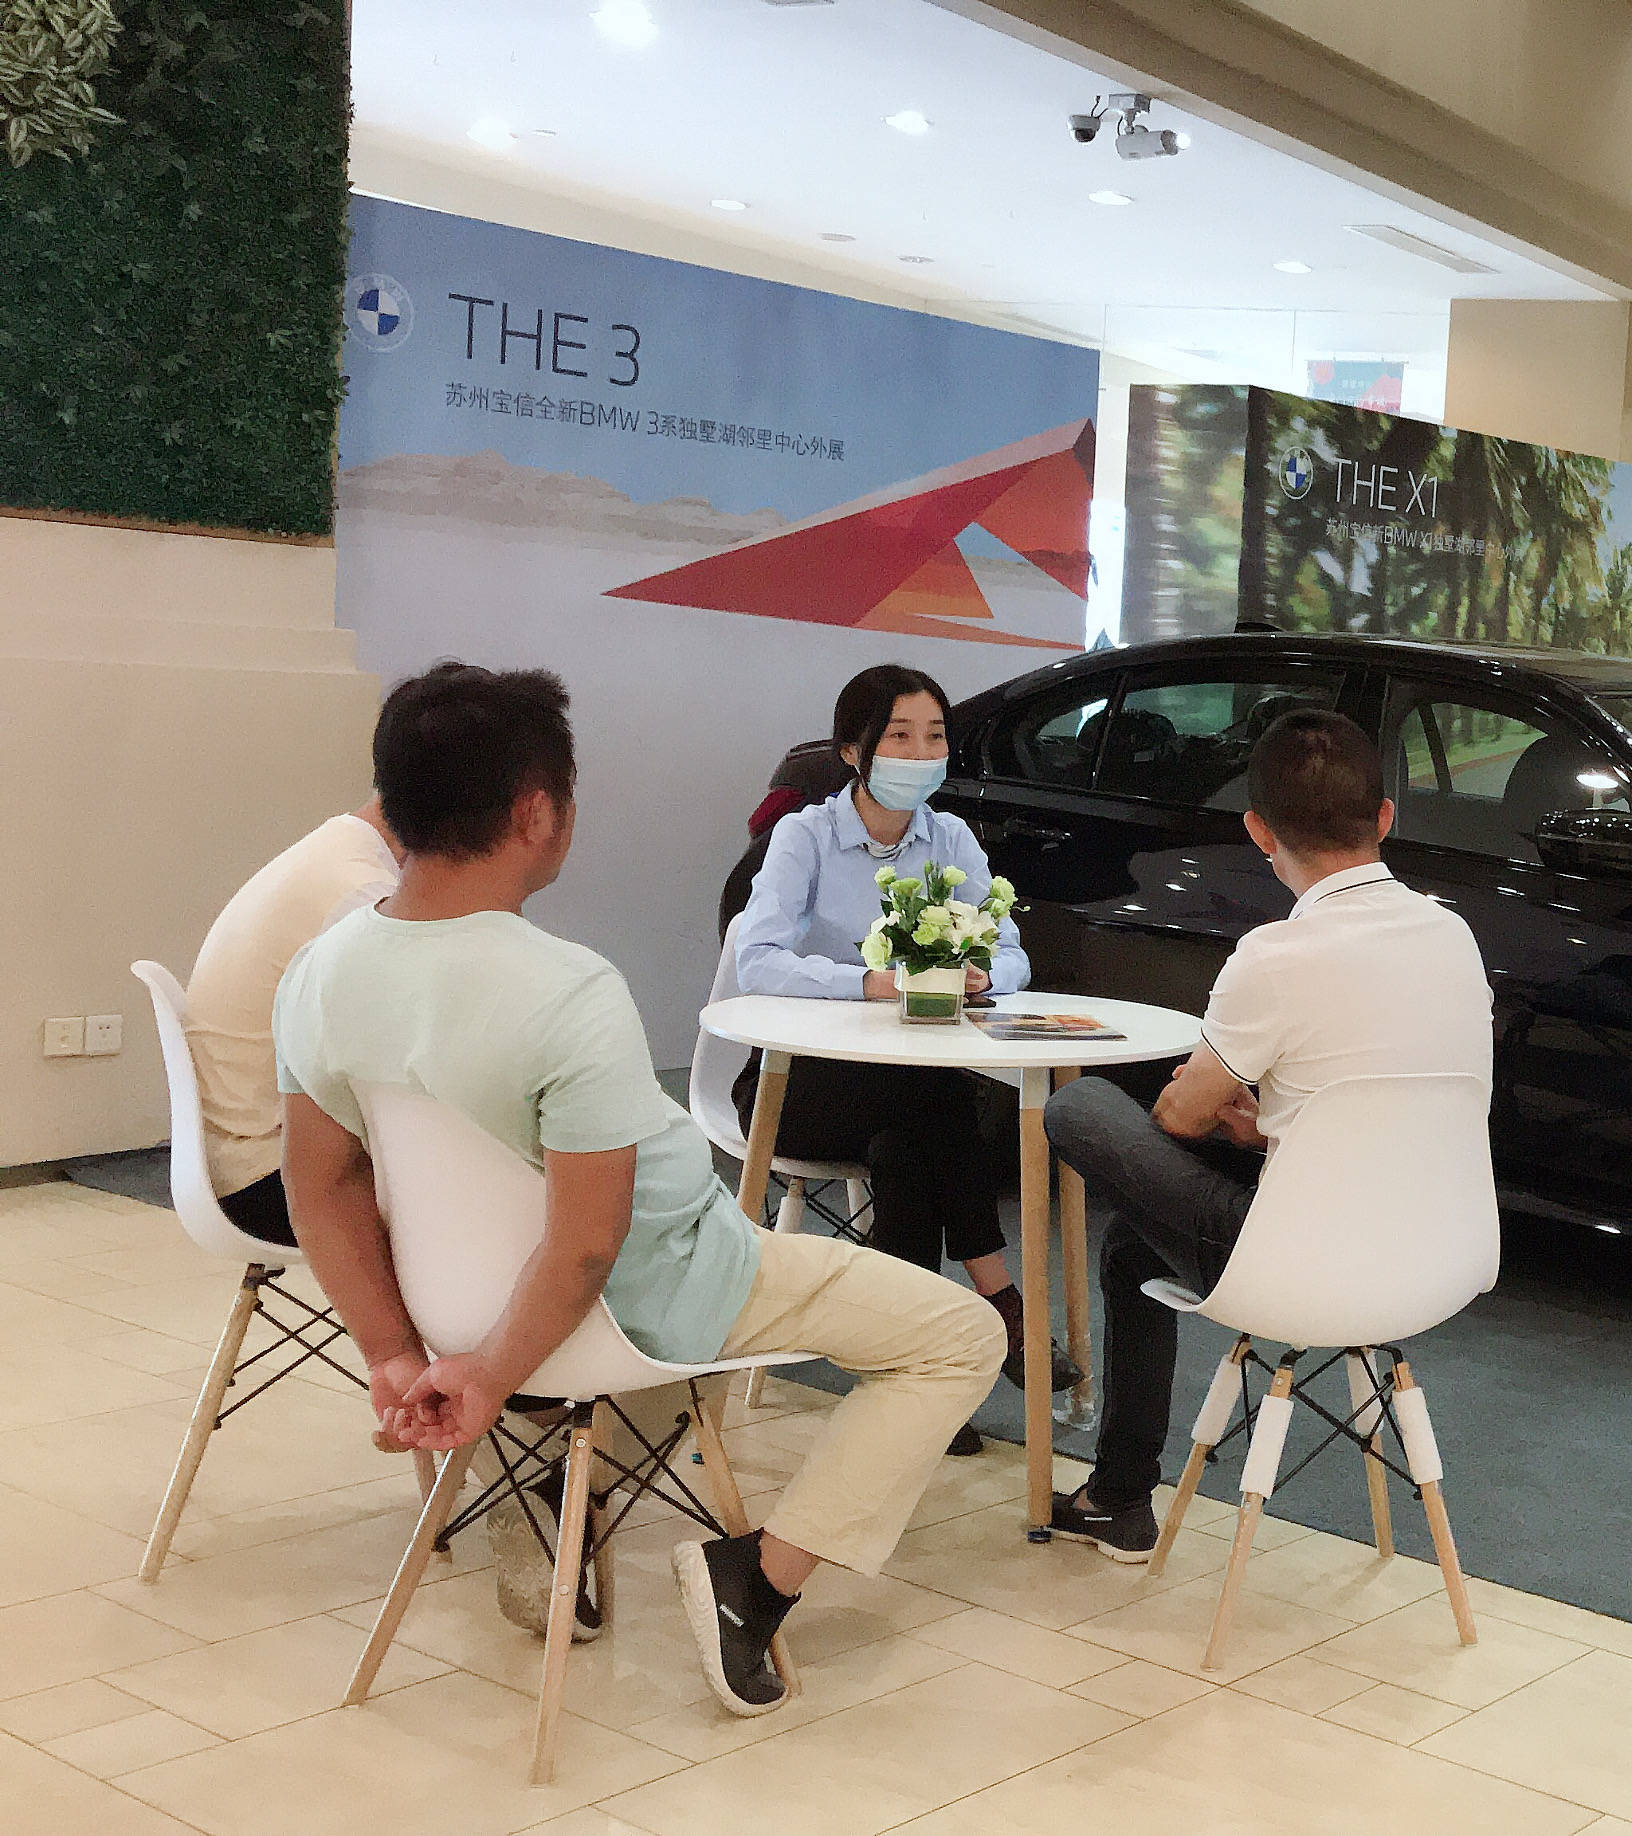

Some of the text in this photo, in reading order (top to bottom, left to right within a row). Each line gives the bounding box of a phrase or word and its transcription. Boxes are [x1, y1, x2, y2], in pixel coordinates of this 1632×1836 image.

[448, 293, 642, 387] THE 3
[445, 381, 845, 461] 苏州宝信全新BMW 3系独墅湖邻里中心外展
[1333, 458, 1439, 518] THE X1
